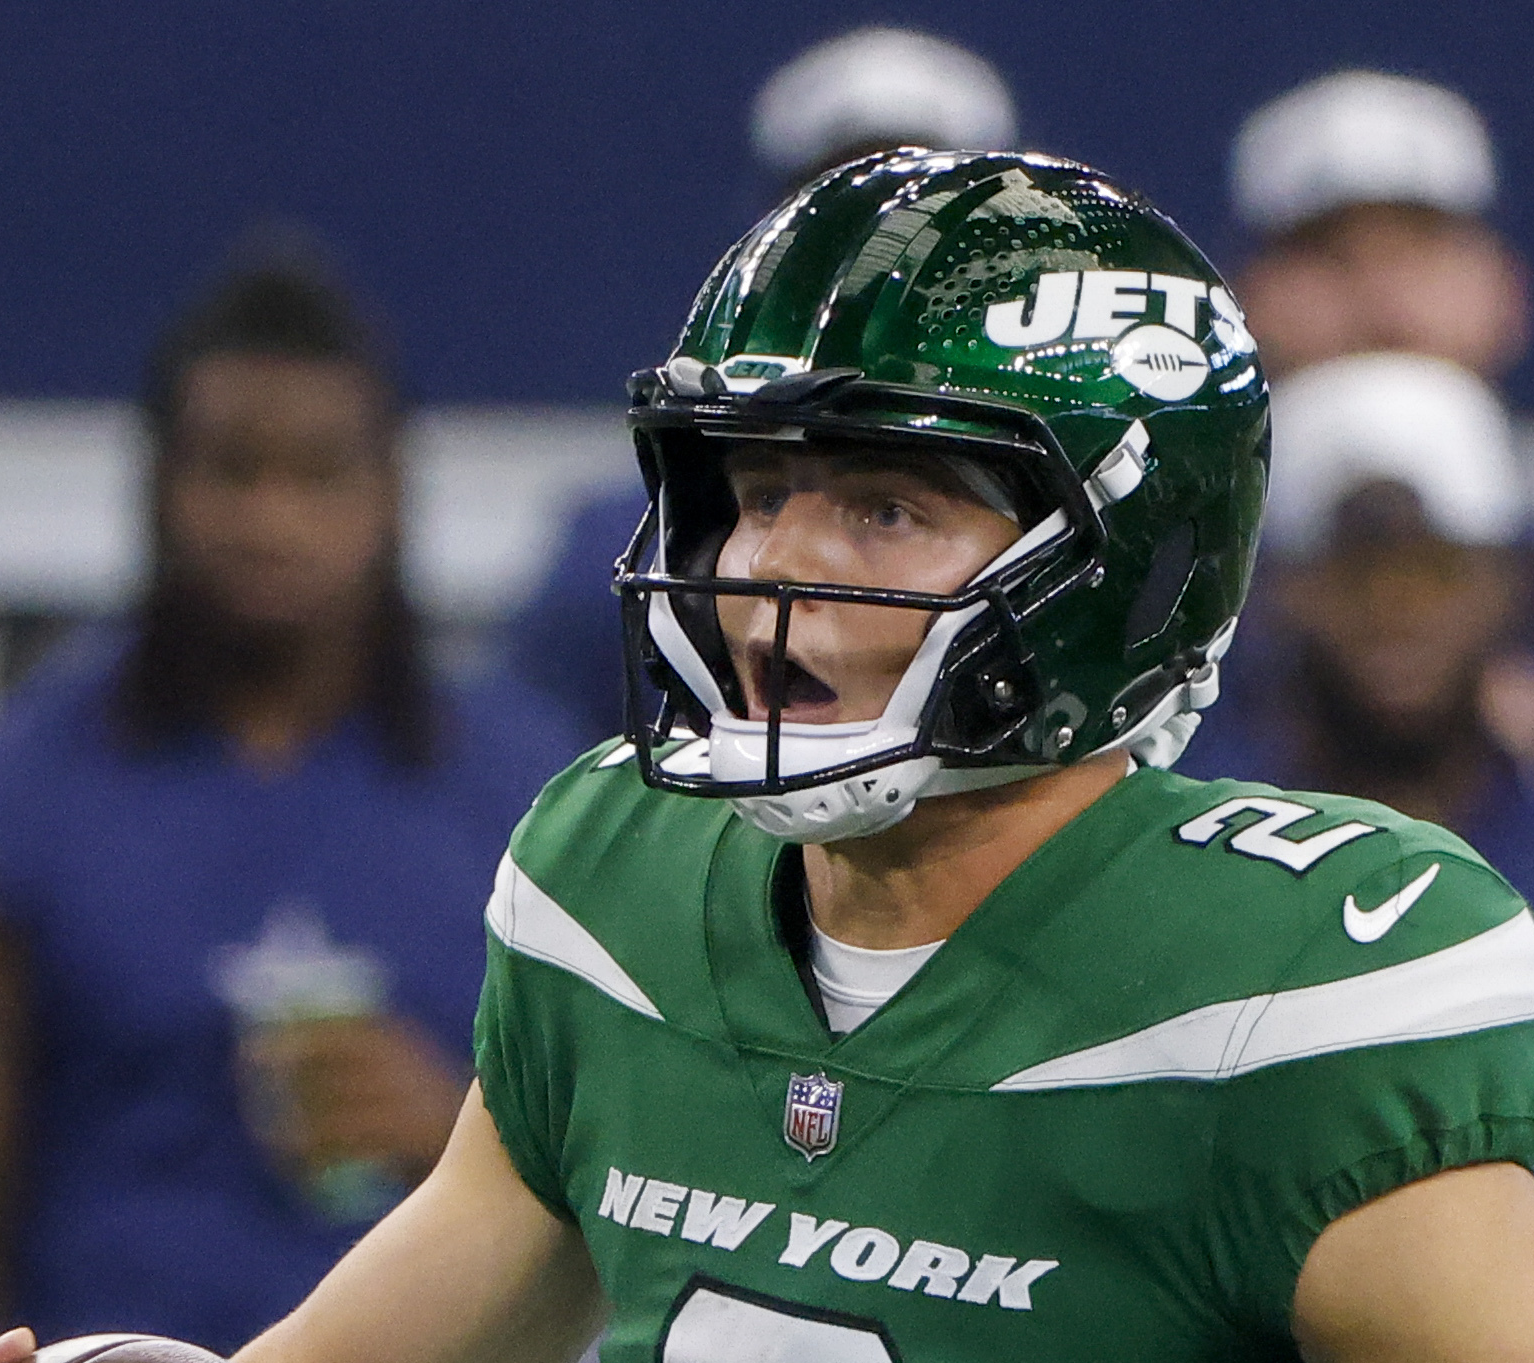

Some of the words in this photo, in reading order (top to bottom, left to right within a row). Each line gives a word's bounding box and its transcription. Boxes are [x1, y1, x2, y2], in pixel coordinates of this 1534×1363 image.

[985, 269, 1257, 355] JETS
[1173, 796, 1387, 879] 2
[792, 1109, 828, 1145] NFL
[597, 1166, 777, 1251] NEW
[778, 1214, 1058, 1311] YORK
